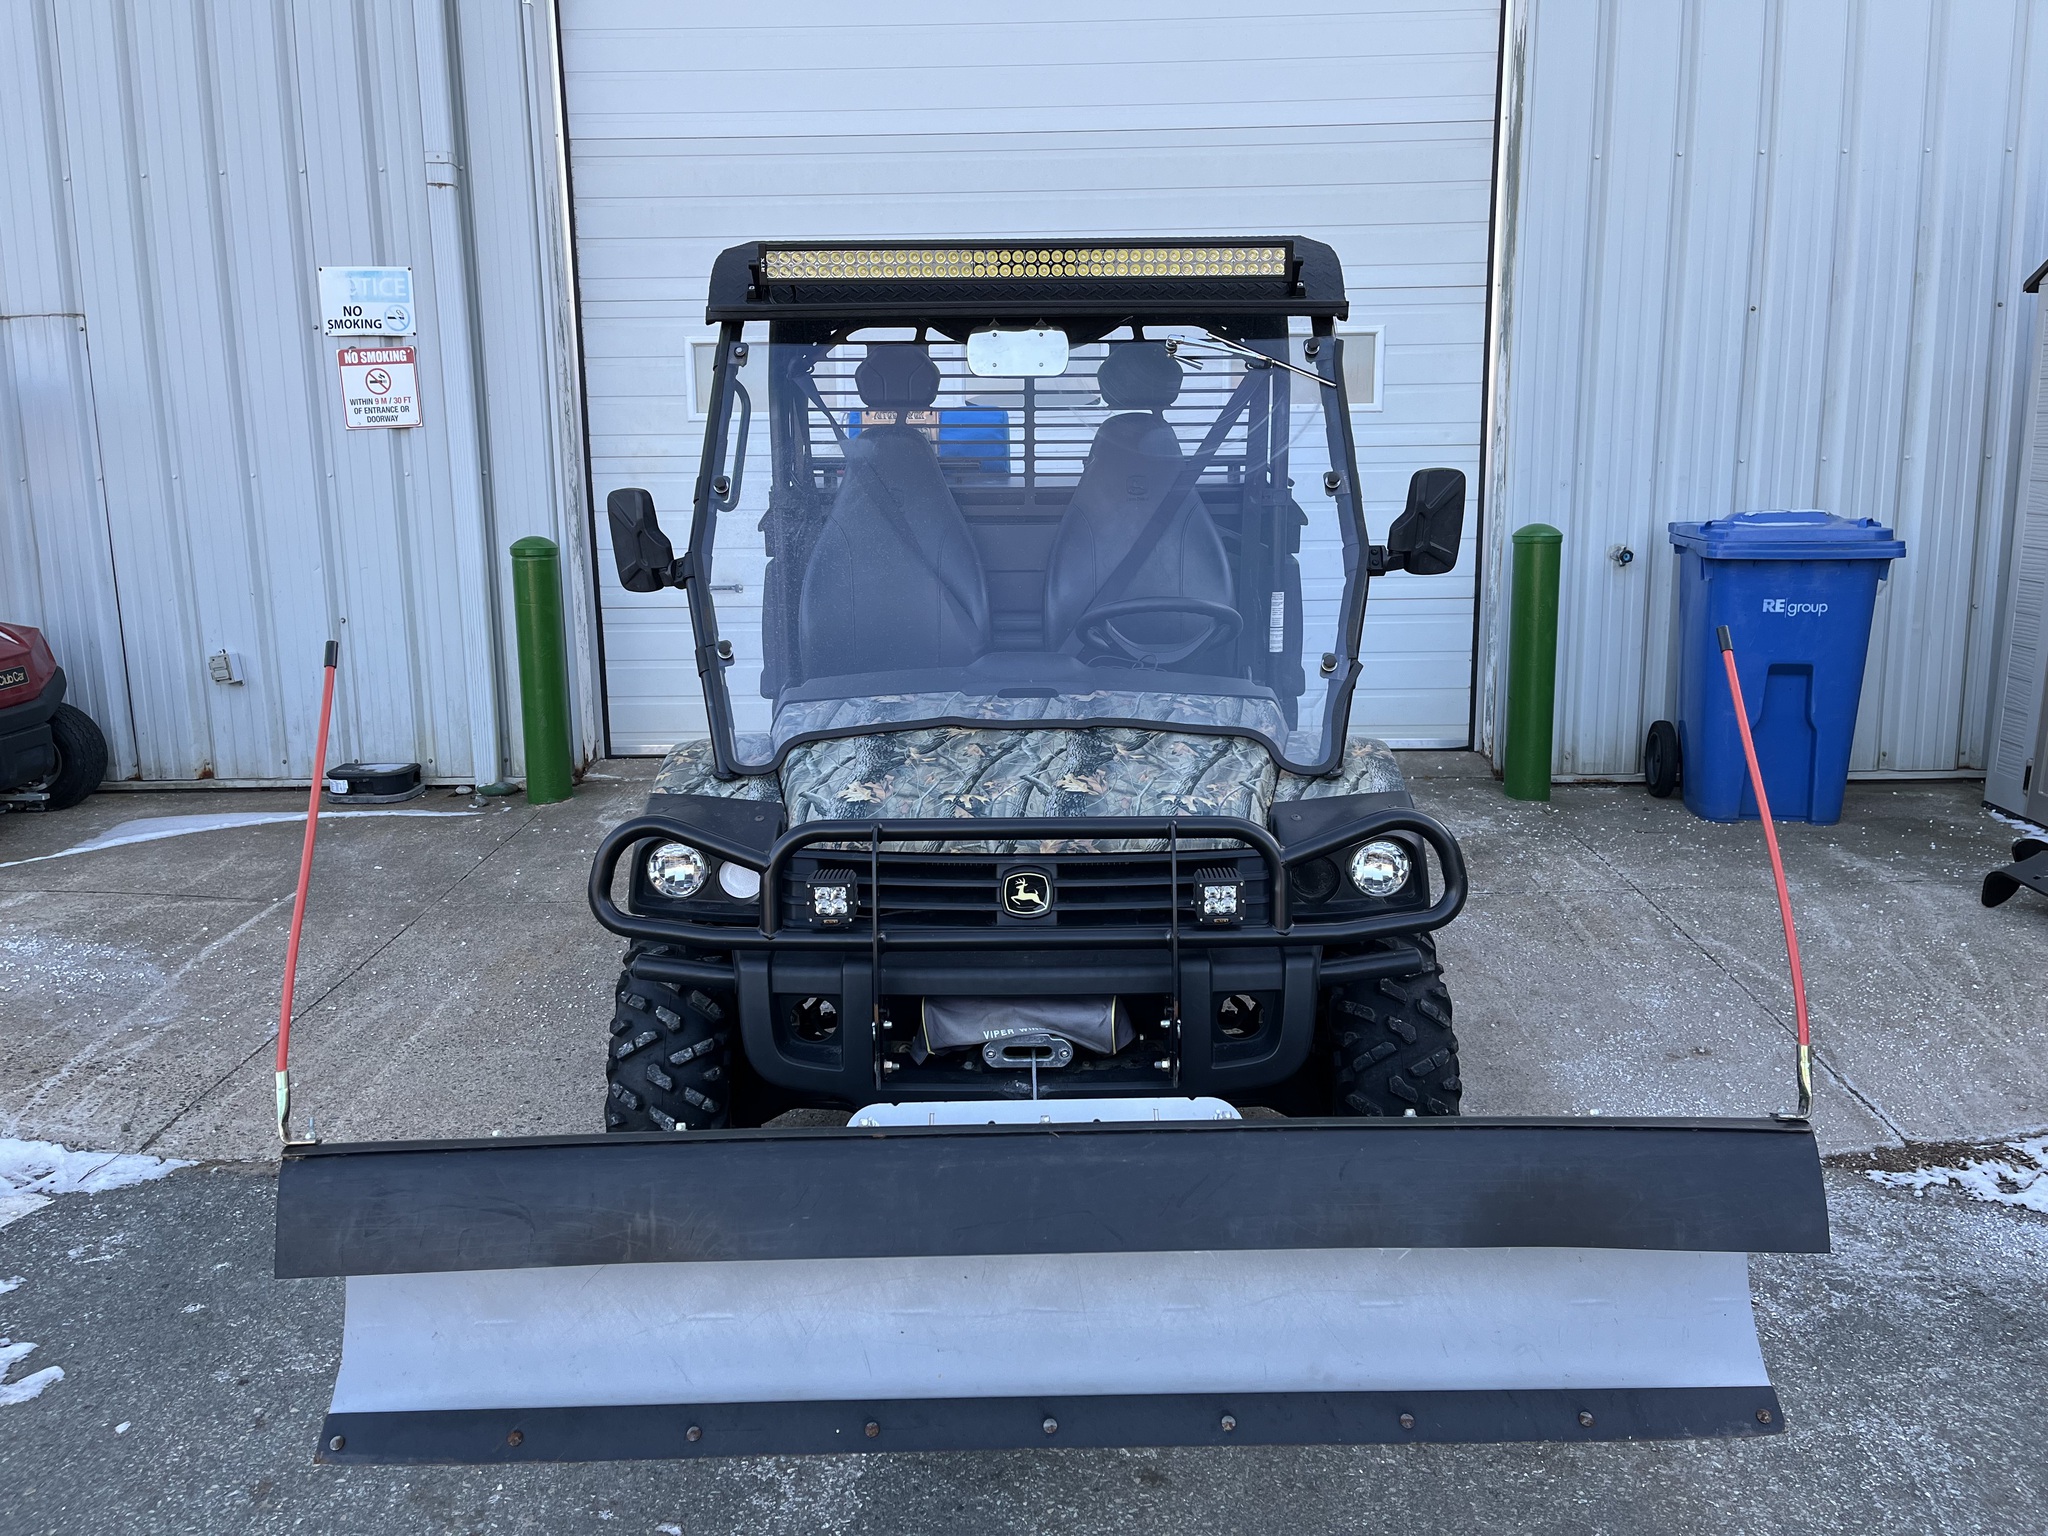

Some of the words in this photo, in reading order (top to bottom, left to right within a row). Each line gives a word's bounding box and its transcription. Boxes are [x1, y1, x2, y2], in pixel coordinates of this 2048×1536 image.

[348, 277, 407, 297] TICE
[343, 305, 362, 317] NO
[327, 319, 382, 330] SMOKING
[344, 351, 359, 364] NO
[360, 349, 407, 363] SMOKING
[349, 398, 374, 406] WITHIN
[403, 396, 412, 404] FT
[364, 406, 399, 414] ENTRANCE
[400, 405, 410, 413] OR
[366, 415, 399, 423] DOORWAY
[983, 1028, 1015, 1039] VIPER
